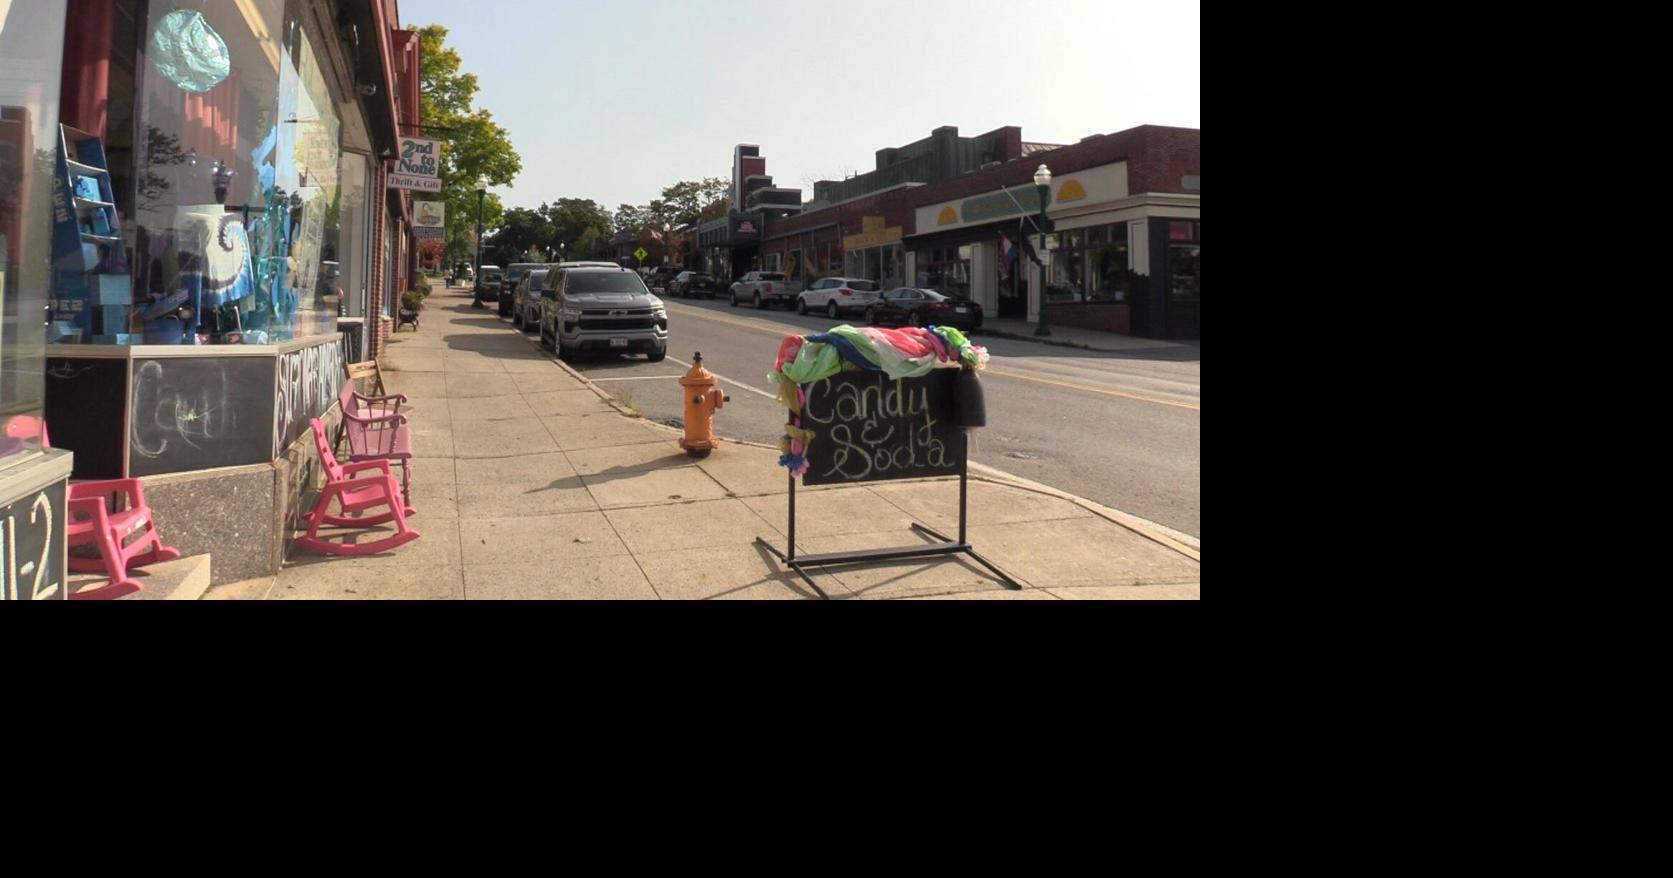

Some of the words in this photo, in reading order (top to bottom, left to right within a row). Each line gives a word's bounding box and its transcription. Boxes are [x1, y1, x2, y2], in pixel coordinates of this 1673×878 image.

[401, 140, 433, 159] 2nd
[398, 159, 436, 175] None
[421, 155, 434, 165] to
[391, 177, 412, 187] Thrift
[423, 182, 439, 190] Gift
[806, 374, 936, 446] Candy
[823, 424, 955, 479] Soda
